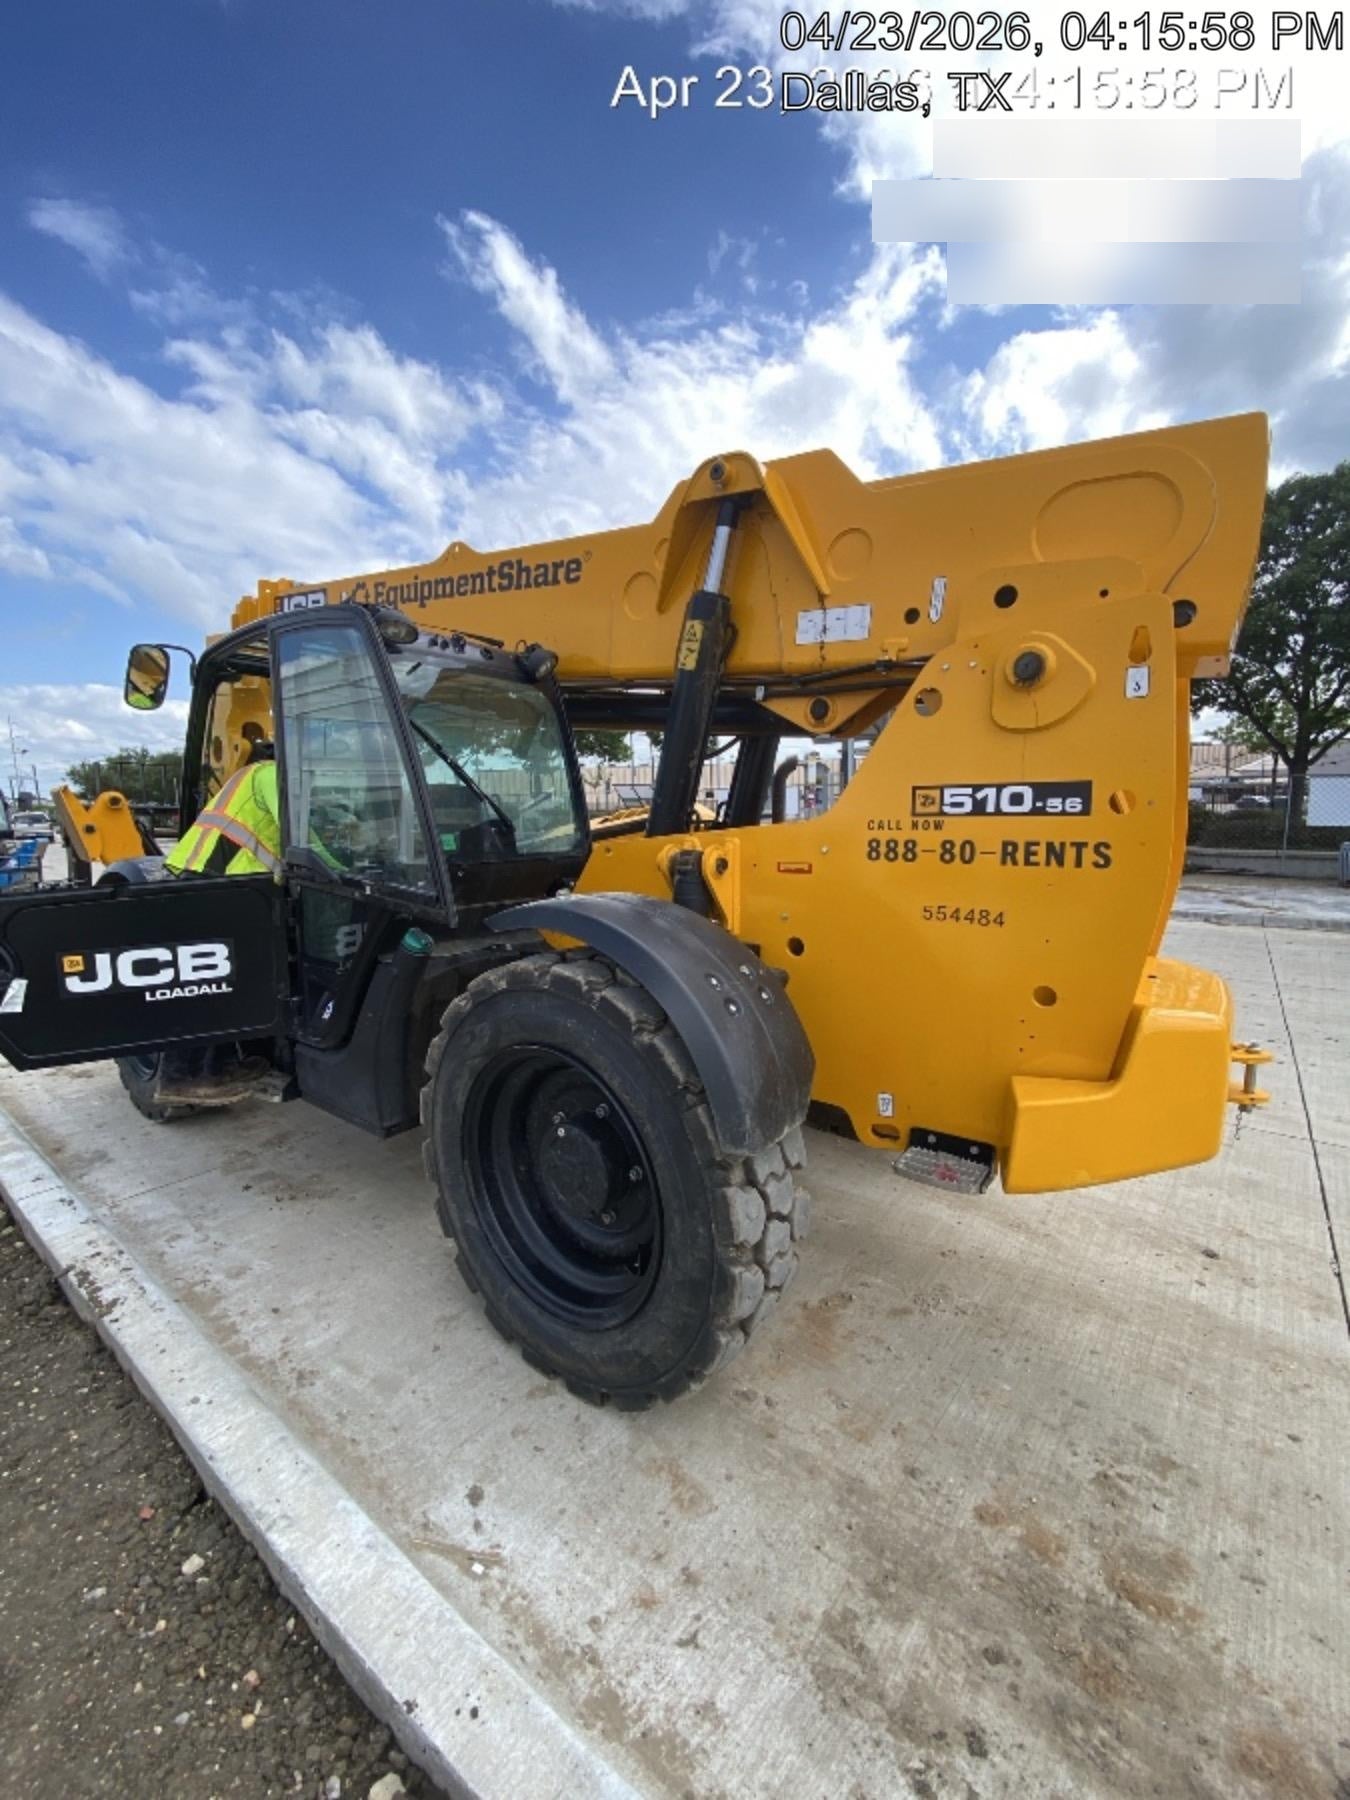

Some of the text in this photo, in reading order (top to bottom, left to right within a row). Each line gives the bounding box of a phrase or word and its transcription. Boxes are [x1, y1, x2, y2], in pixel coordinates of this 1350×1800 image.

[942, 785, 1083, 813] 510-56
[867, 819, 945, 831] CALL NOW
[866, 838, 1112, 869] 888-80-RENTS
[923, 905, 1006, 928] 554484
[64, 943, 232, 993] JCB
[145, 982, 233, 1001] LOADALL
